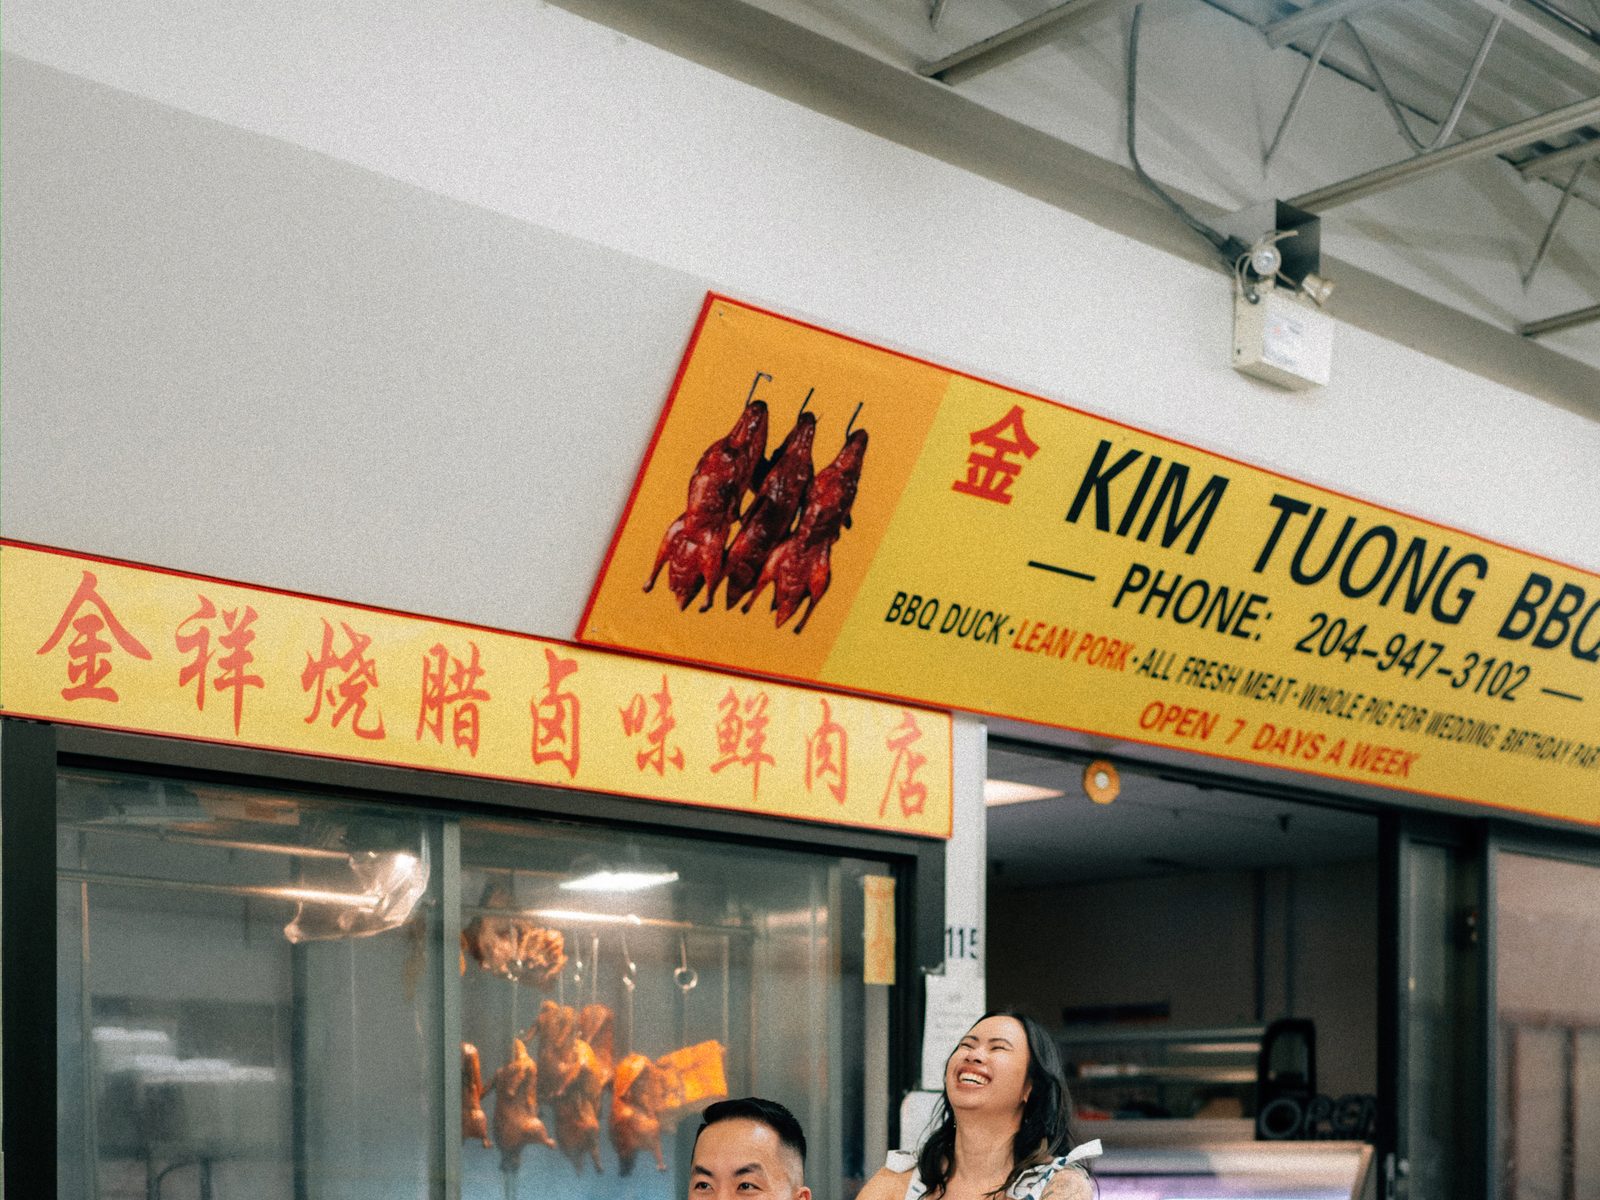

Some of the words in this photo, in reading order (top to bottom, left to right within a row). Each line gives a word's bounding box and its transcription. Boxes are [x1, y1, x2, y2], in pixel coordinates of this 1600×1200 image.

[952, 405, 1040, 505] 金
[1065, 439, 1231, 555] KIM
[1253, 493, 1488, 625] TUONG
[885, 591, 940, 631] BBQ
[940, 603, 1010, 645] DUCK
[1012, 619, 1078, 661] LEAN
[1072, 632, 1137, 672] PORK
[1137, 648, 1177, 681] ALL
[1176, 655, 1244, 694] FRESH
[1240, 669, 1297, 705] MEAT
[1299, 682, 1365, 720] WHOLE
[1363, 697, 1394, 727] PIG
[1392, 703, 1429, 734] FOR
[1425, 711, 1500, 750] WEDDING
[1499, 728, 1574, 762] BIRTHDAY
[1111, 563, 1272, 642] PHONE:
[1295, 613, 1531, 701] 204-947-3102
[1138, 700, 1220, 743] OPEN
[1225, 719, 1248, 745] 7
[1251, 722, 1327, 761] DAYS
[1323, 738, 1348, 765] A
[1348, 742, 1422, 778] WEEK
